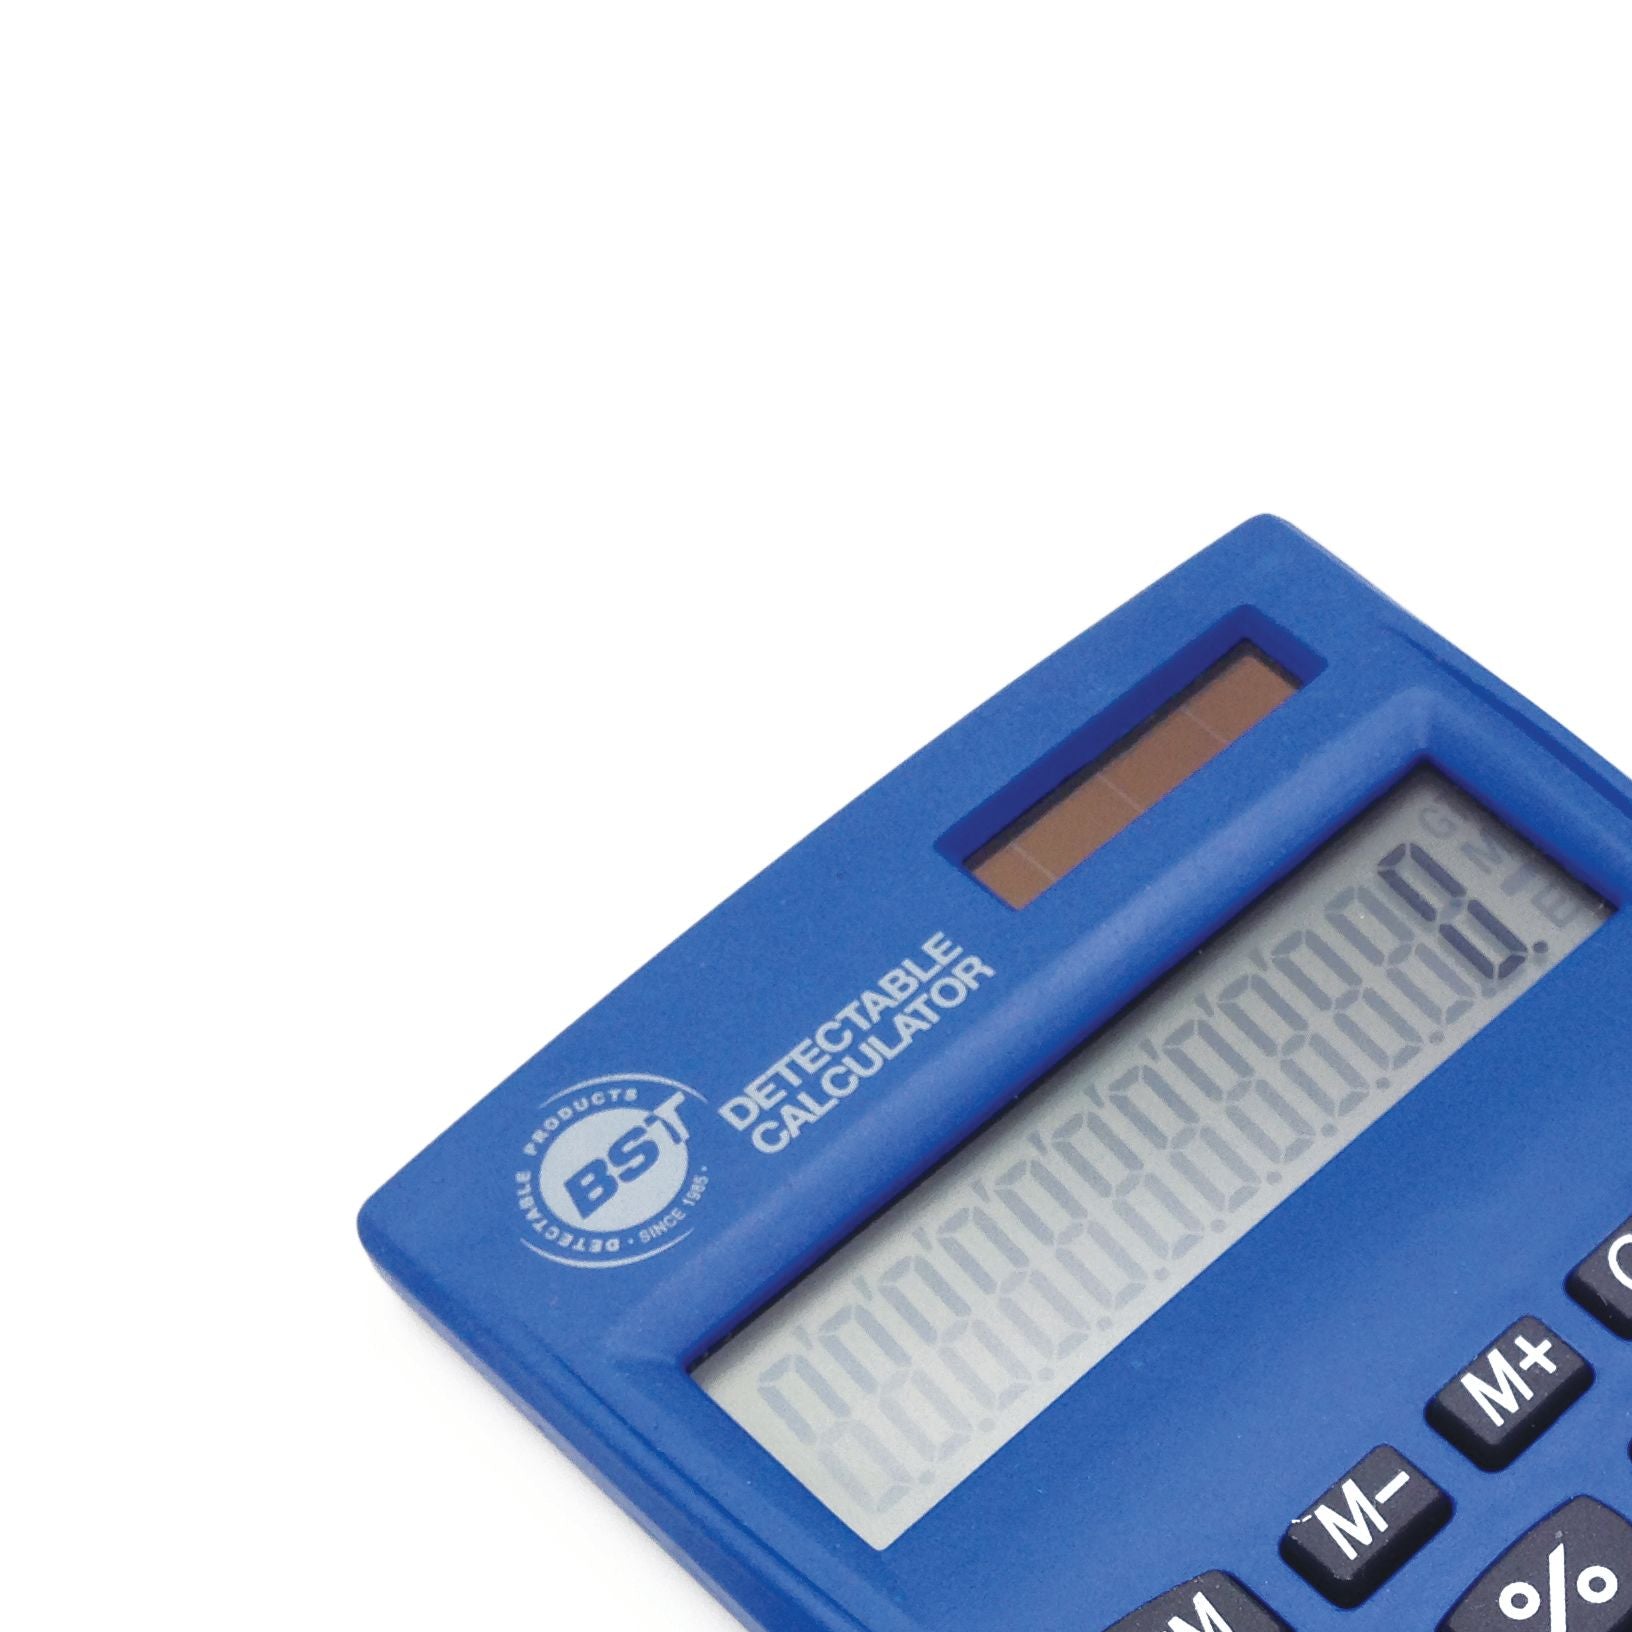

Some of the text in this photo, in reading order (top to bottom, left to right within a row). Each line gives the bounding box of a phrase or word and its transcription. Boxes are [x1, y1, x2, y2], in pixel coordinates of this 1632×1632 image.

[717, 931, 964, 1132] DETECTABLE
[751, 955, 997, 1154] CALCULATOR
[514, 1087, 639, 1253] DETECTABLE PRODUCTS
[563, 1091, 690, 1220] BST
[638, 1206, 687, 1244] SINCE
[1460, 1334, 1557, 1428] M+
[1313, 1470, 1411, 1561] M-
